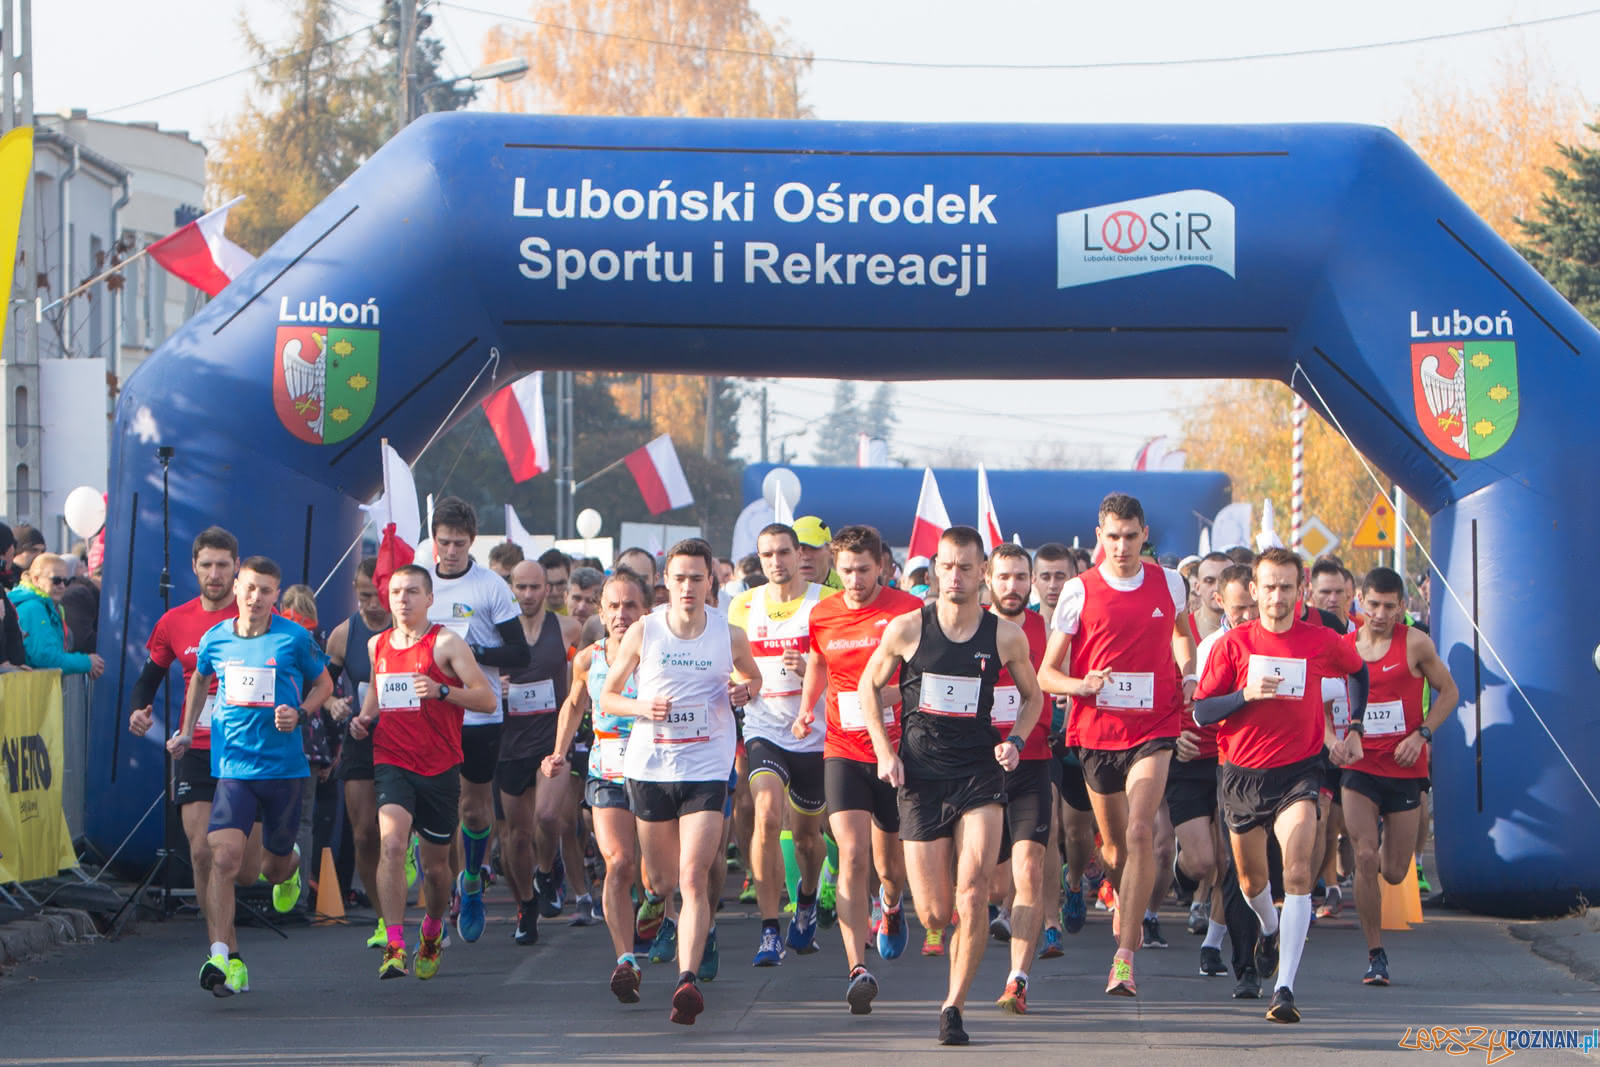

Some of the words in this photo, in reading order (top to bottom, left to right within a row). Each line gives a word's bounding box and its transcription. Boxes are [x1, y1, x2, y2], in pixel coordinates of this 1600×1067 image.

[513, 177, 754, 223] Luboński
[773, 181, 997, 225] Ośrodek
[1084, 254, 1116, 263] Luboński
[1117, 254, 1148, 263] Ośrodek
[1150, 254, 1174, 263] Sportu
[1179, 254, 1214, 263] Rekreacji
[518, 236, 694, 291] Sportu
[713, 241, 724, 284] i
[744, 241, 988, 297] Rekreacji
[279, 296, 380, 325] Luboń
[1410, 309, 1513, 337] Luboń
[763, 638, 798, 649] POLSKA
[671, 659, 712, 668] DANFLOR
[780, 668, 787, 676] 4
[1274, 667, 1281, 676] 5
[242, 676, 255, 686] 22
[385, 682, 408, 693] 1480
[947, 686, 954, 695] 2
[1119, 682, 1132, 692] 13
[523, 690, 536, 699] 23
[1008, 695, 1015, 705] 3
[667, 712, 695, 724] 1343
[1367, 710, 1391, 721] 1127
